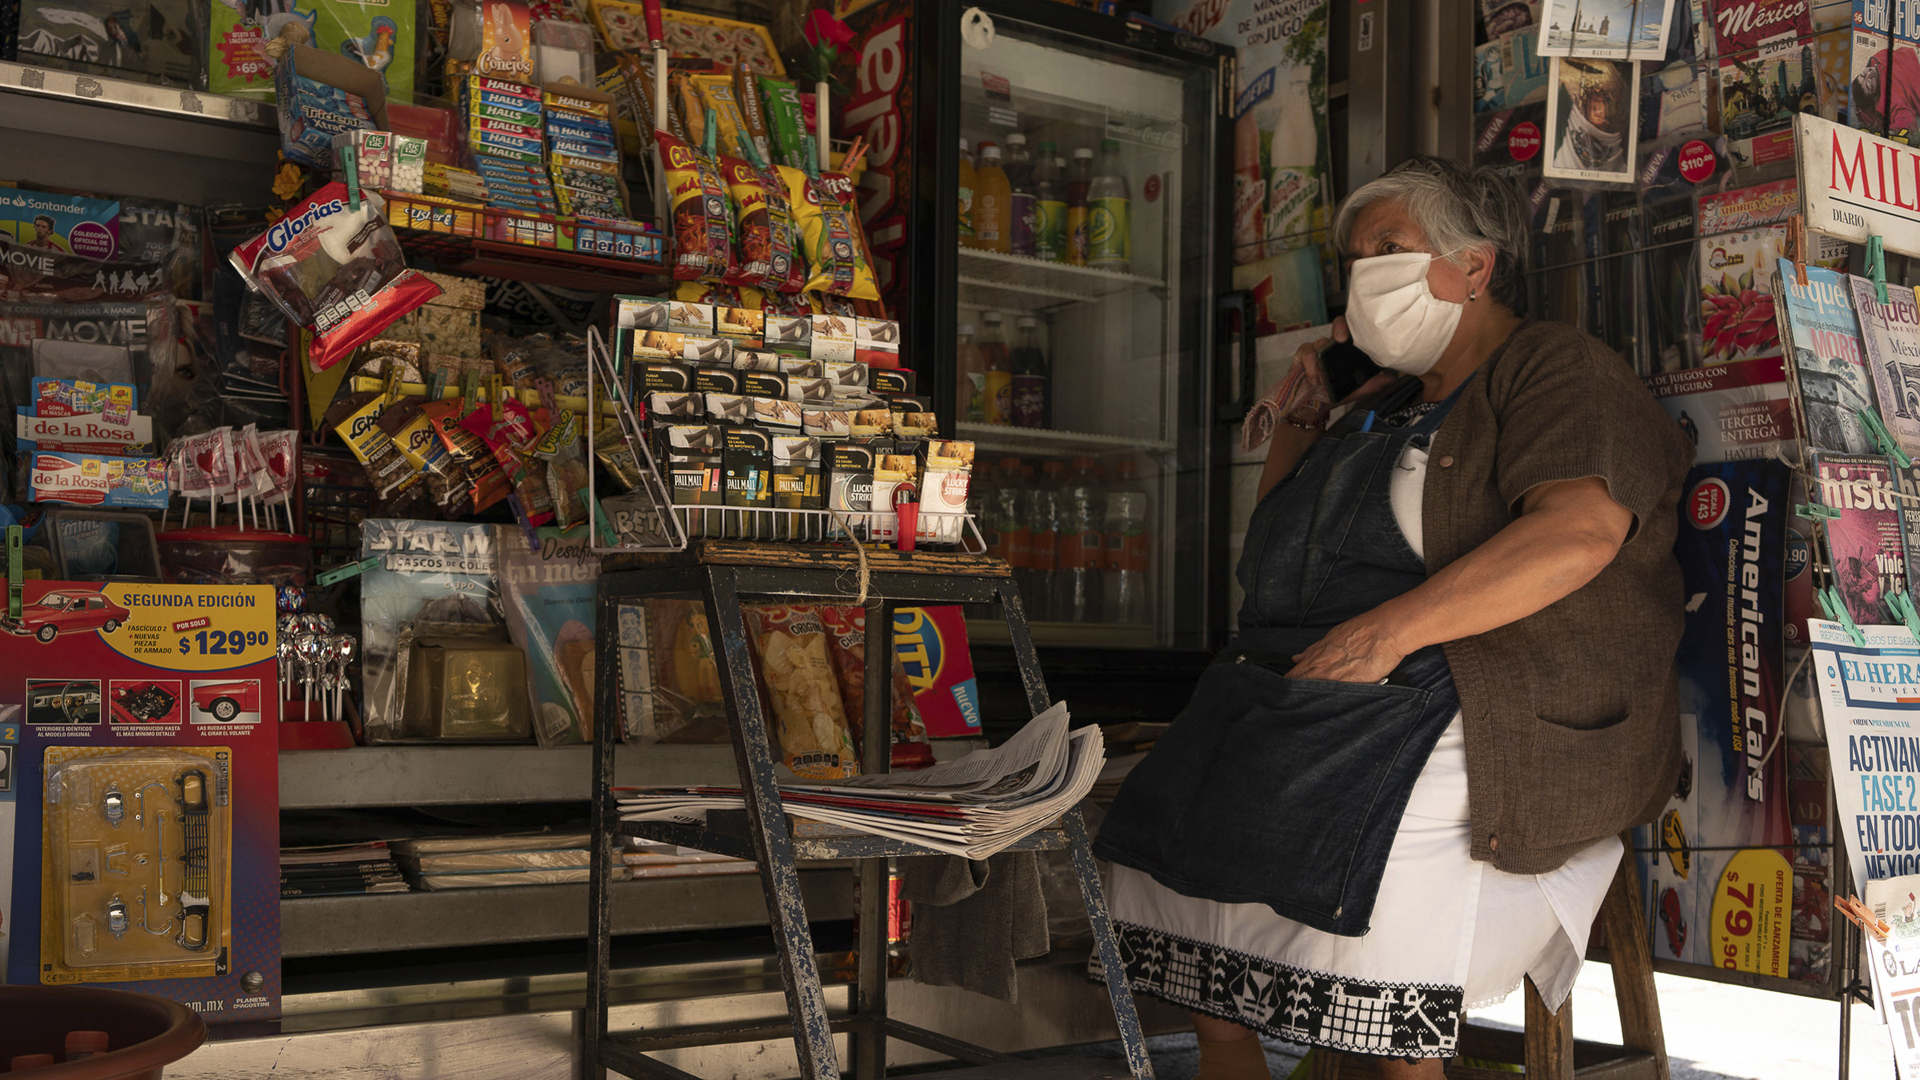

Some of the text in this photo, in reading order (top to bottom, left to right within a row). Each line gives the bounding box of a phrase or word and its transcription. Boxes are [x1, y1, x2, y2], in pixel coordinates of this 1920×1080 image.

[1717, 1, 1807, 37] México
[1238, 20, 1252, 34] DE
[1264, 19, 1302, 44] JUGO
[478, 54, 531, 76] Conejos
[486, 80, 522, 93] HALLS
[488, 94, 523, 106] HALLS
[557, 96, 591, 109] HALLS
[302, 105, 361, 126] Trident
[486, 106, 521, 119] HALLS
[556, 112, 581, 122] HALLS
[487, 120, 522, 133] HALLS
[561, 127, 591, 138] HALLS
[488, 133, 524, 147] HALLS
[1479, 117, 1504, 152] NUEVA
[369, 140, 383, 148] tac
[405, 147, 419, 155] tac
[556, 142, 588, 152] HALLS
[487, 146, 522, 160] HALLS
[569, 157, 602, 170] HALLS
[1642, 153, 1664, 183] NUEVA
[28, 199, 86, 215] Santander
[120, 207, 197, 232] STAR
[266, 199, 343, 252] Glorias
[1832, 208, 1865, 228] DIARIO
[73, 230, 109, 240] COLECCIÓN
[74, 237, 98, 246] OFICIAL
[74, 245, 109, 254] ESTAMPAS
[580, 238, 642, 256] mentos
[1827, 250, 1833, 258] X
[0, 249, 55, 275] MOVIE
[110, 306, 137, 315] MANO
[46, 320, 147, 351] MOVIE
[1655, 367, 1728, 385] DE JUEGOS CON
[1660, 380, 1713, 395] DE FIGURAS
[1719, 414, 1773, 429] TERCERA
[34, 421, 135, 440] de la Rosa
[1721, 426, 1780, 443] ENTREGA!
[34, 473, 107, 488] de la Rosa
[674, 474, 702, 487] PALL MALL
[727, 478, 755, 491] PALL MALL
[779, 480, 803, 493] PALL MALL
[947, 478, 969, 487] LUCKY
[853, 485, 872, 493] LUCKY
[944, 487, 967, 496] STRIKE
[1697, 489, 1709, 520] 1/43
[1710, 489, 1718, 517] ESCALA
[370, 531, 461, 553] STAR
[397, 558, 442, 568] CASCOS
[1727, 539, 1739, 581] Colecciona
[507, 562, 537, 583] tu
[1727, 582, 1735, 596] los
[123, 591, 255, 607] SEGUNDA EDICIÓN
[1727, 597, 1738, 626] muscle
[127, 624, 162, 632] FASCÍCULO
[190, 619, 206, 628] SOLO
[1741, 487, 1769, 802] American Cars
[1727, 646, 1736, 664] más
[1841, 660, 1866, 682] EL
[1728, 665, 1738, 695] famosos
[953, 686, 978, 724] nuevo
[1730, 696, 1739, 722] made
[4, 728, 15, 741] 2
[1732, 723, 1738, 734] in
[1733, 735, 1742, 751] USA
[1849, 735, 1920, 772] ACTIVAN
[1860, 774, 1917, 812] FASE 2
[1856, 815, 1878, 852] EN
[1775, 870, 1784, 904] OFERTA
[1774, 907, 1782, 918] DE
